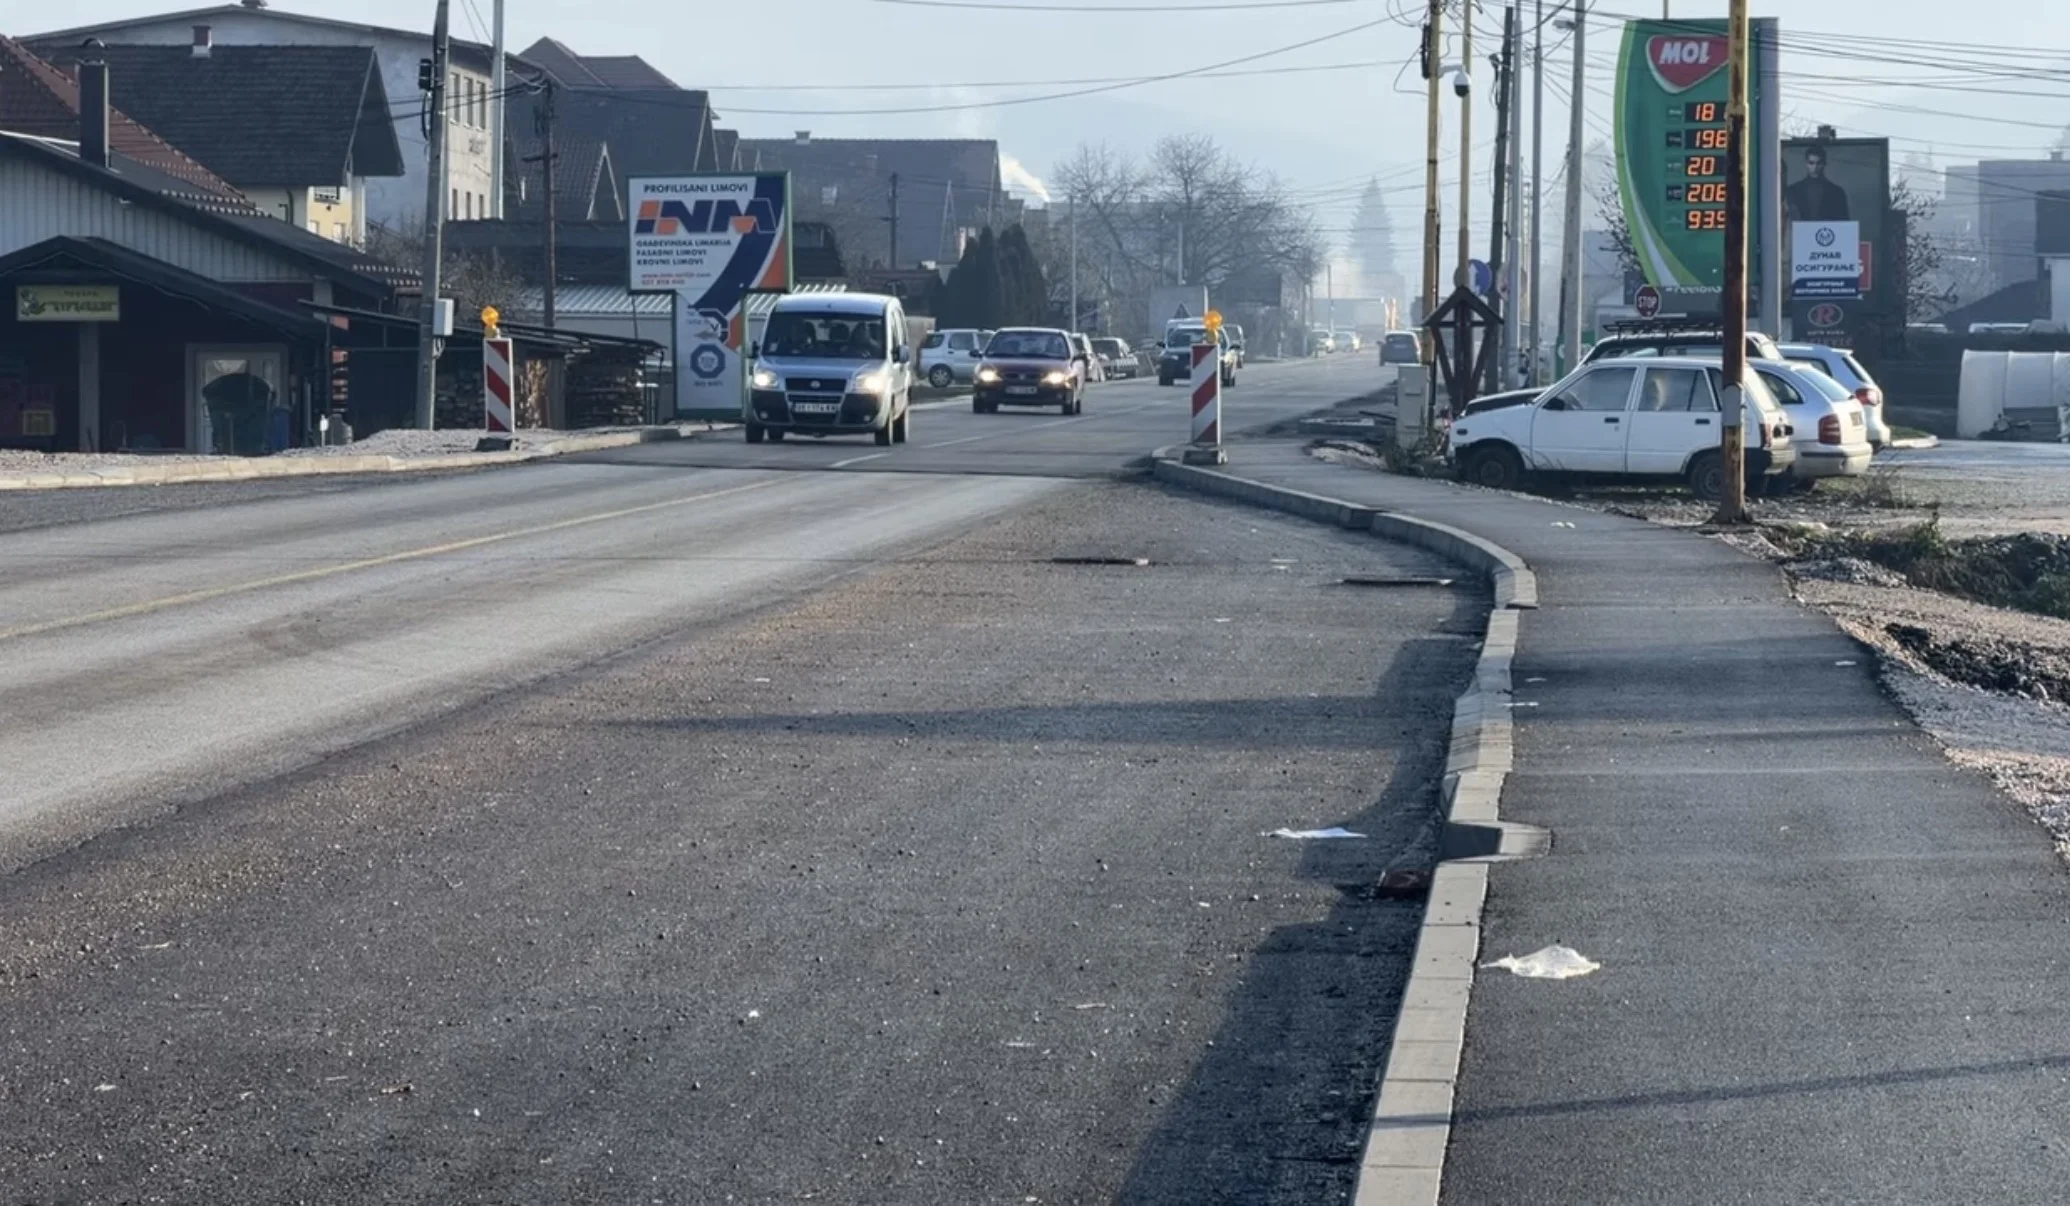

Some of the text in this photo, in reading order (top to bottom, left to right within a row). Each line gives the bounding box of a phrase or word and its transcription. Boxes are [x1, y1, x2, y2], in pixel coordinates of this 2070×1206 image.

[1659, 41, 1711, 64] MOL
[1695, 103, 1715, 121] 18
[1687, 156, 1715, 175] 20
[643, 183, 748, 193] PROFILISANI LIMOVI
[1809, 251, 1842, 260] ДУНАВ
[637, 258, 704, 266] KROVNI LIMOVI
[1795, 263, 1856, 273] ОСИГУРАЊЕ
[1637, 296, 1658, 309] STOP
